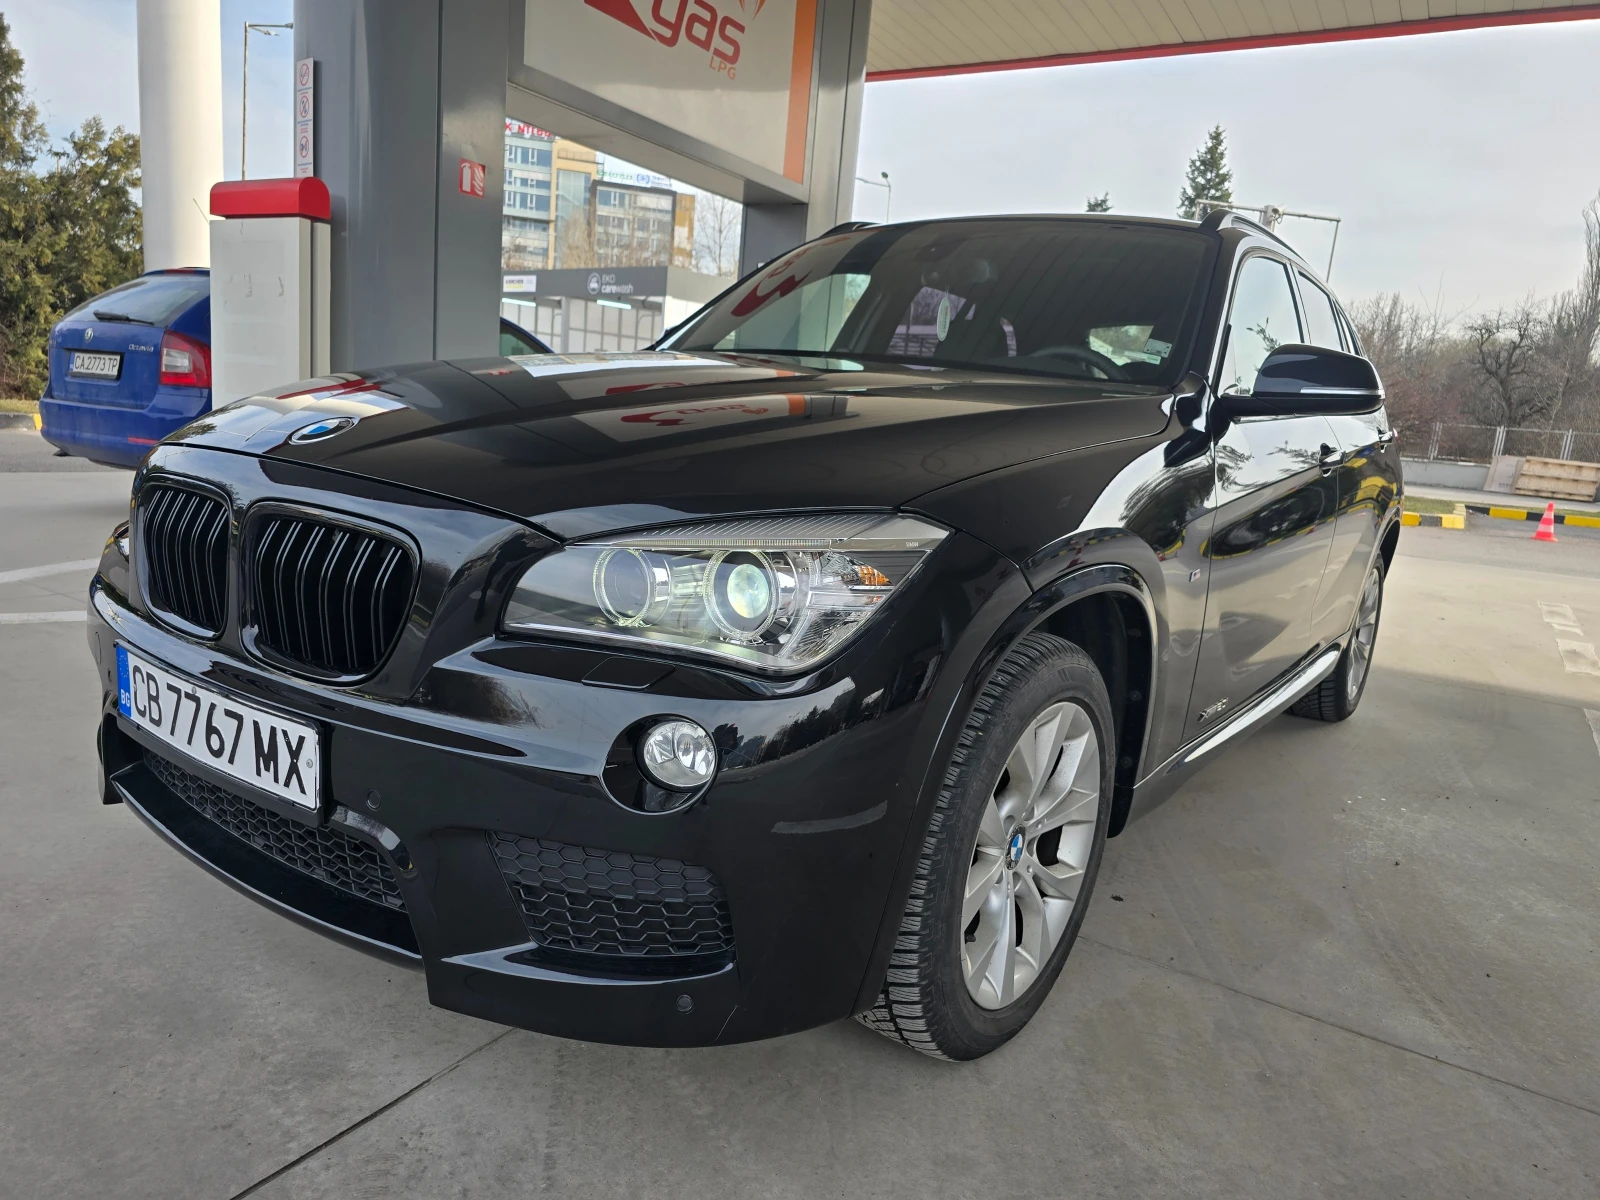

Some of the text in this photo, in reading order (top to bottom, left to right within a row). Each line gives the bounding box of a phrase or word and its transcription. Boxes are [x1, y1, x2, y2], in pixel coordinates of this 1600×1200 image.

[709, 56, 737, 80] LPG
[601, 273, 616, 284] EKO
[601, 282, 634, 294] carewash
[128, 343, 154, 352] Octavia
[120, 688, 131, 708] BG
[132, 664, 307, 796] CB 7767 MX
